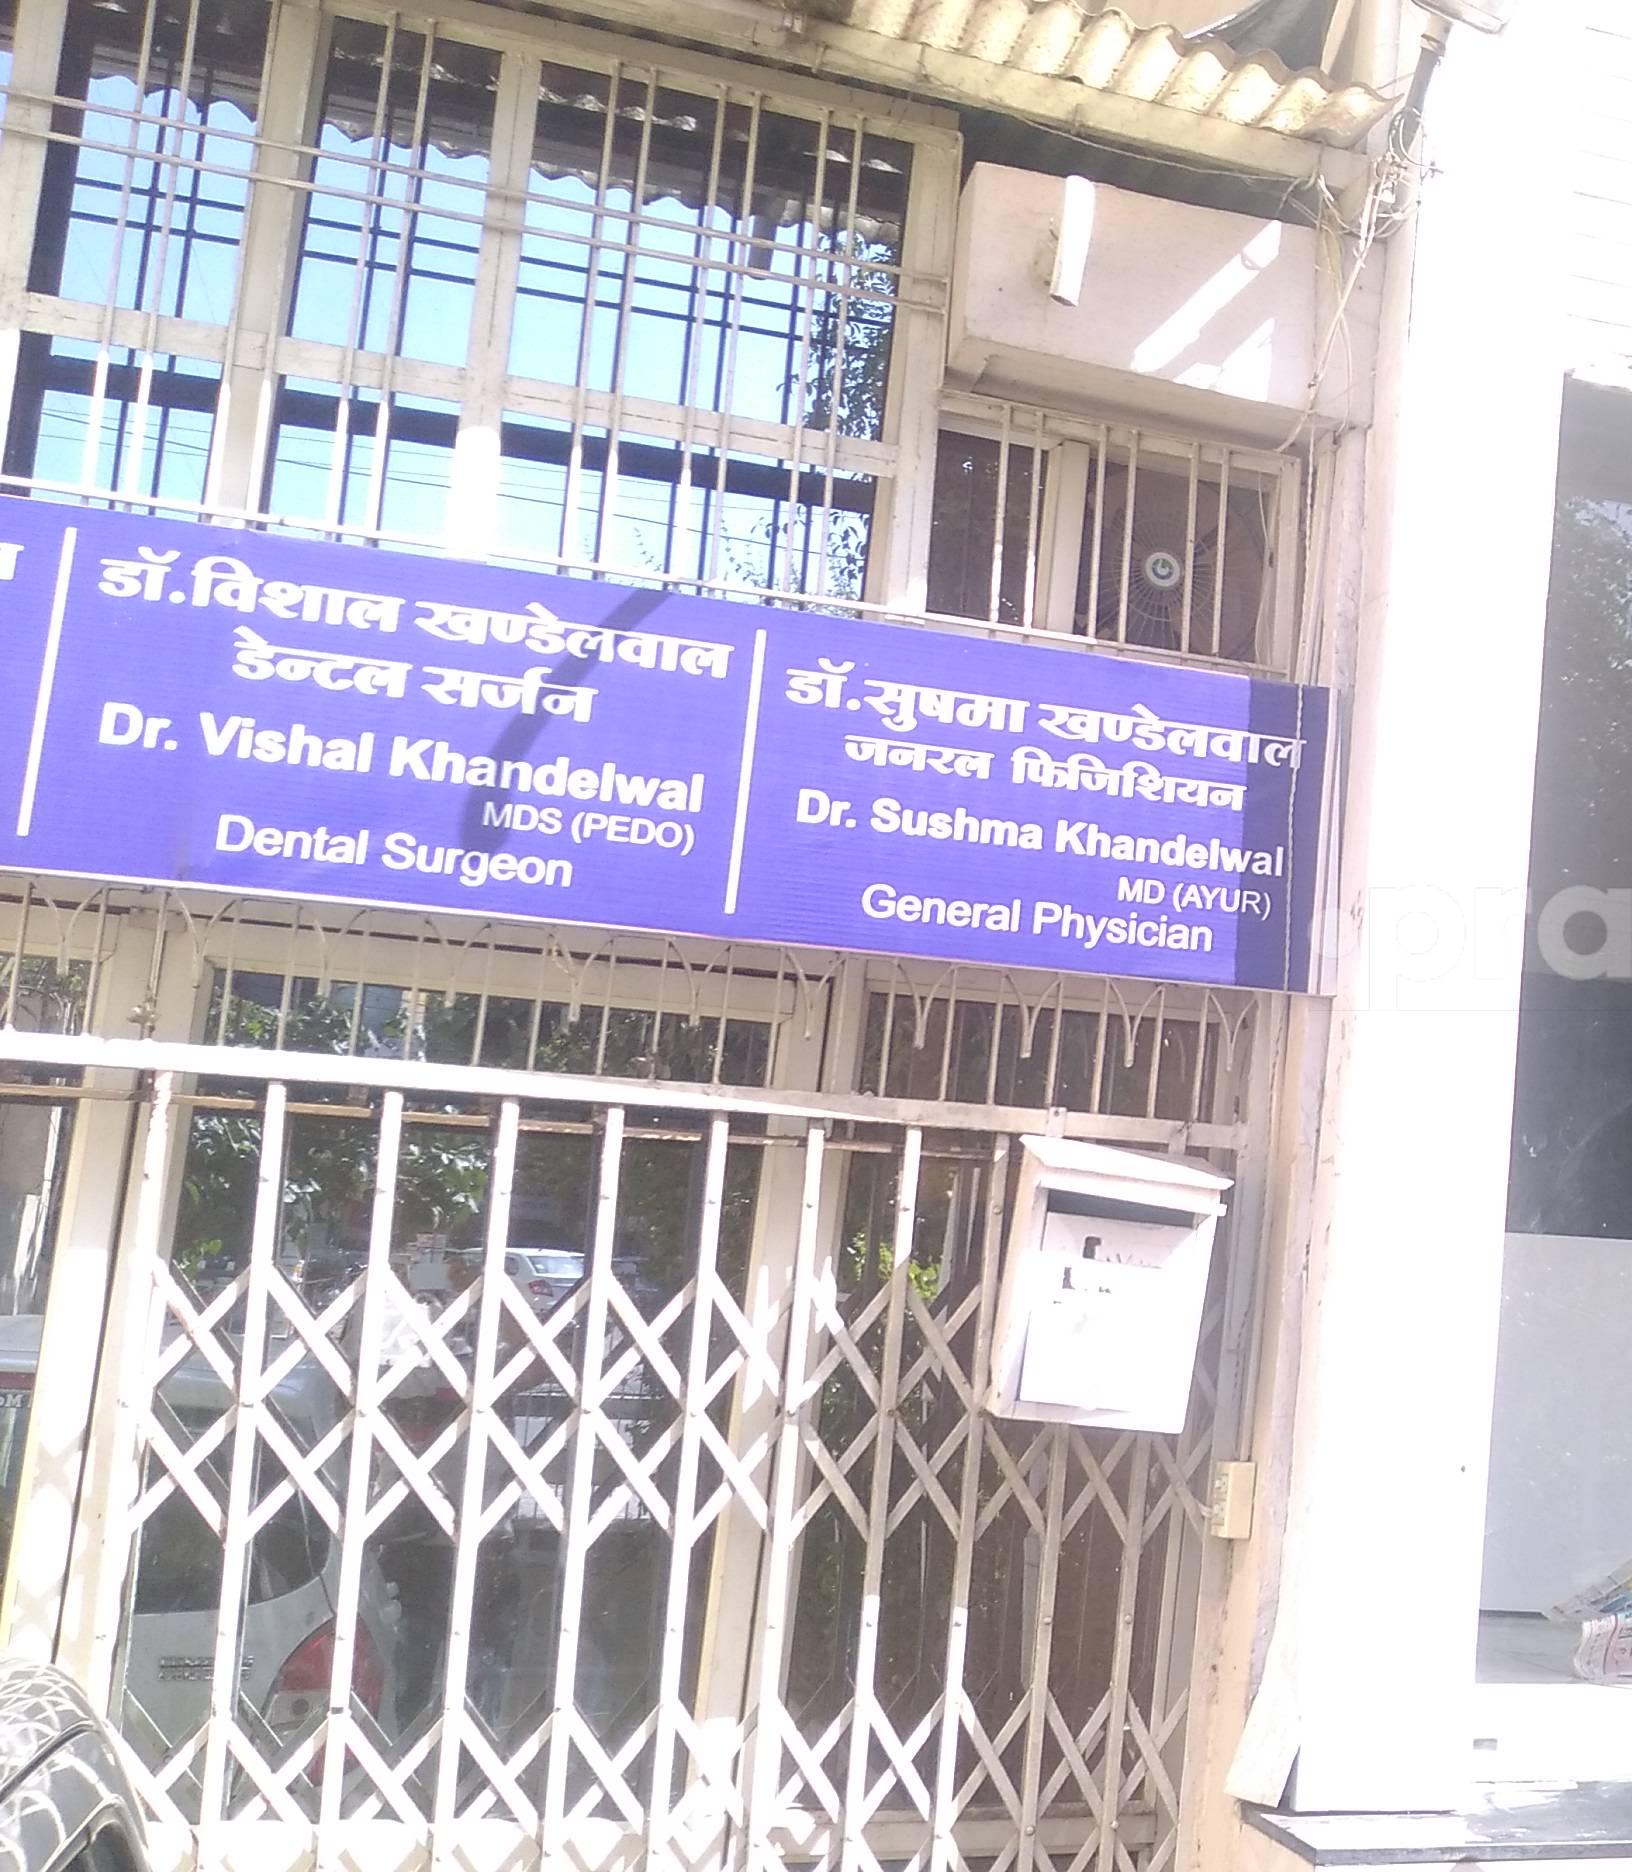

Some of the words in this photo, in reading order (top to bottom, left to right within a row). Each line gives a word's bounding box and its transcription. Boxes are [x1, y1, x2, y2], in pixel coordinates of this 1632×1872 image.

[232, 625, 413, 699] डेन्टल
[421, 666, 599, 723] सर्जन
[414, 601, 735, 679] खण्डेलवाल
[99, 702, 178, 751] Dr.
[200, 712, 376, 773] Vishal
[389, 736, 705, 813] Khandelwal
[845, 734, 994, 780] जनरल
[1011, 746, 1247, 812] फिजिशियन
[1038, 703, 1306, 769] खण्डेलवाल
[216, 814, 370, 866] Dental
[382, 832, 573, 888] Surgeon
[483, 801, 563, 835] MDS
[571, 811, 695, 856] (PEDO)
[797, 788, 858, 829] Dr.
[871, 798, 1043, 851] Sushma
[1056, 820, 1284, 877] Khandelwal
[862, 883, 1022, 933] General
[1033, 901, 1213, 952] Physician
[1118, 876, 1166, 904] MD
[1173, 882, 1272, 921] (AYUR)
